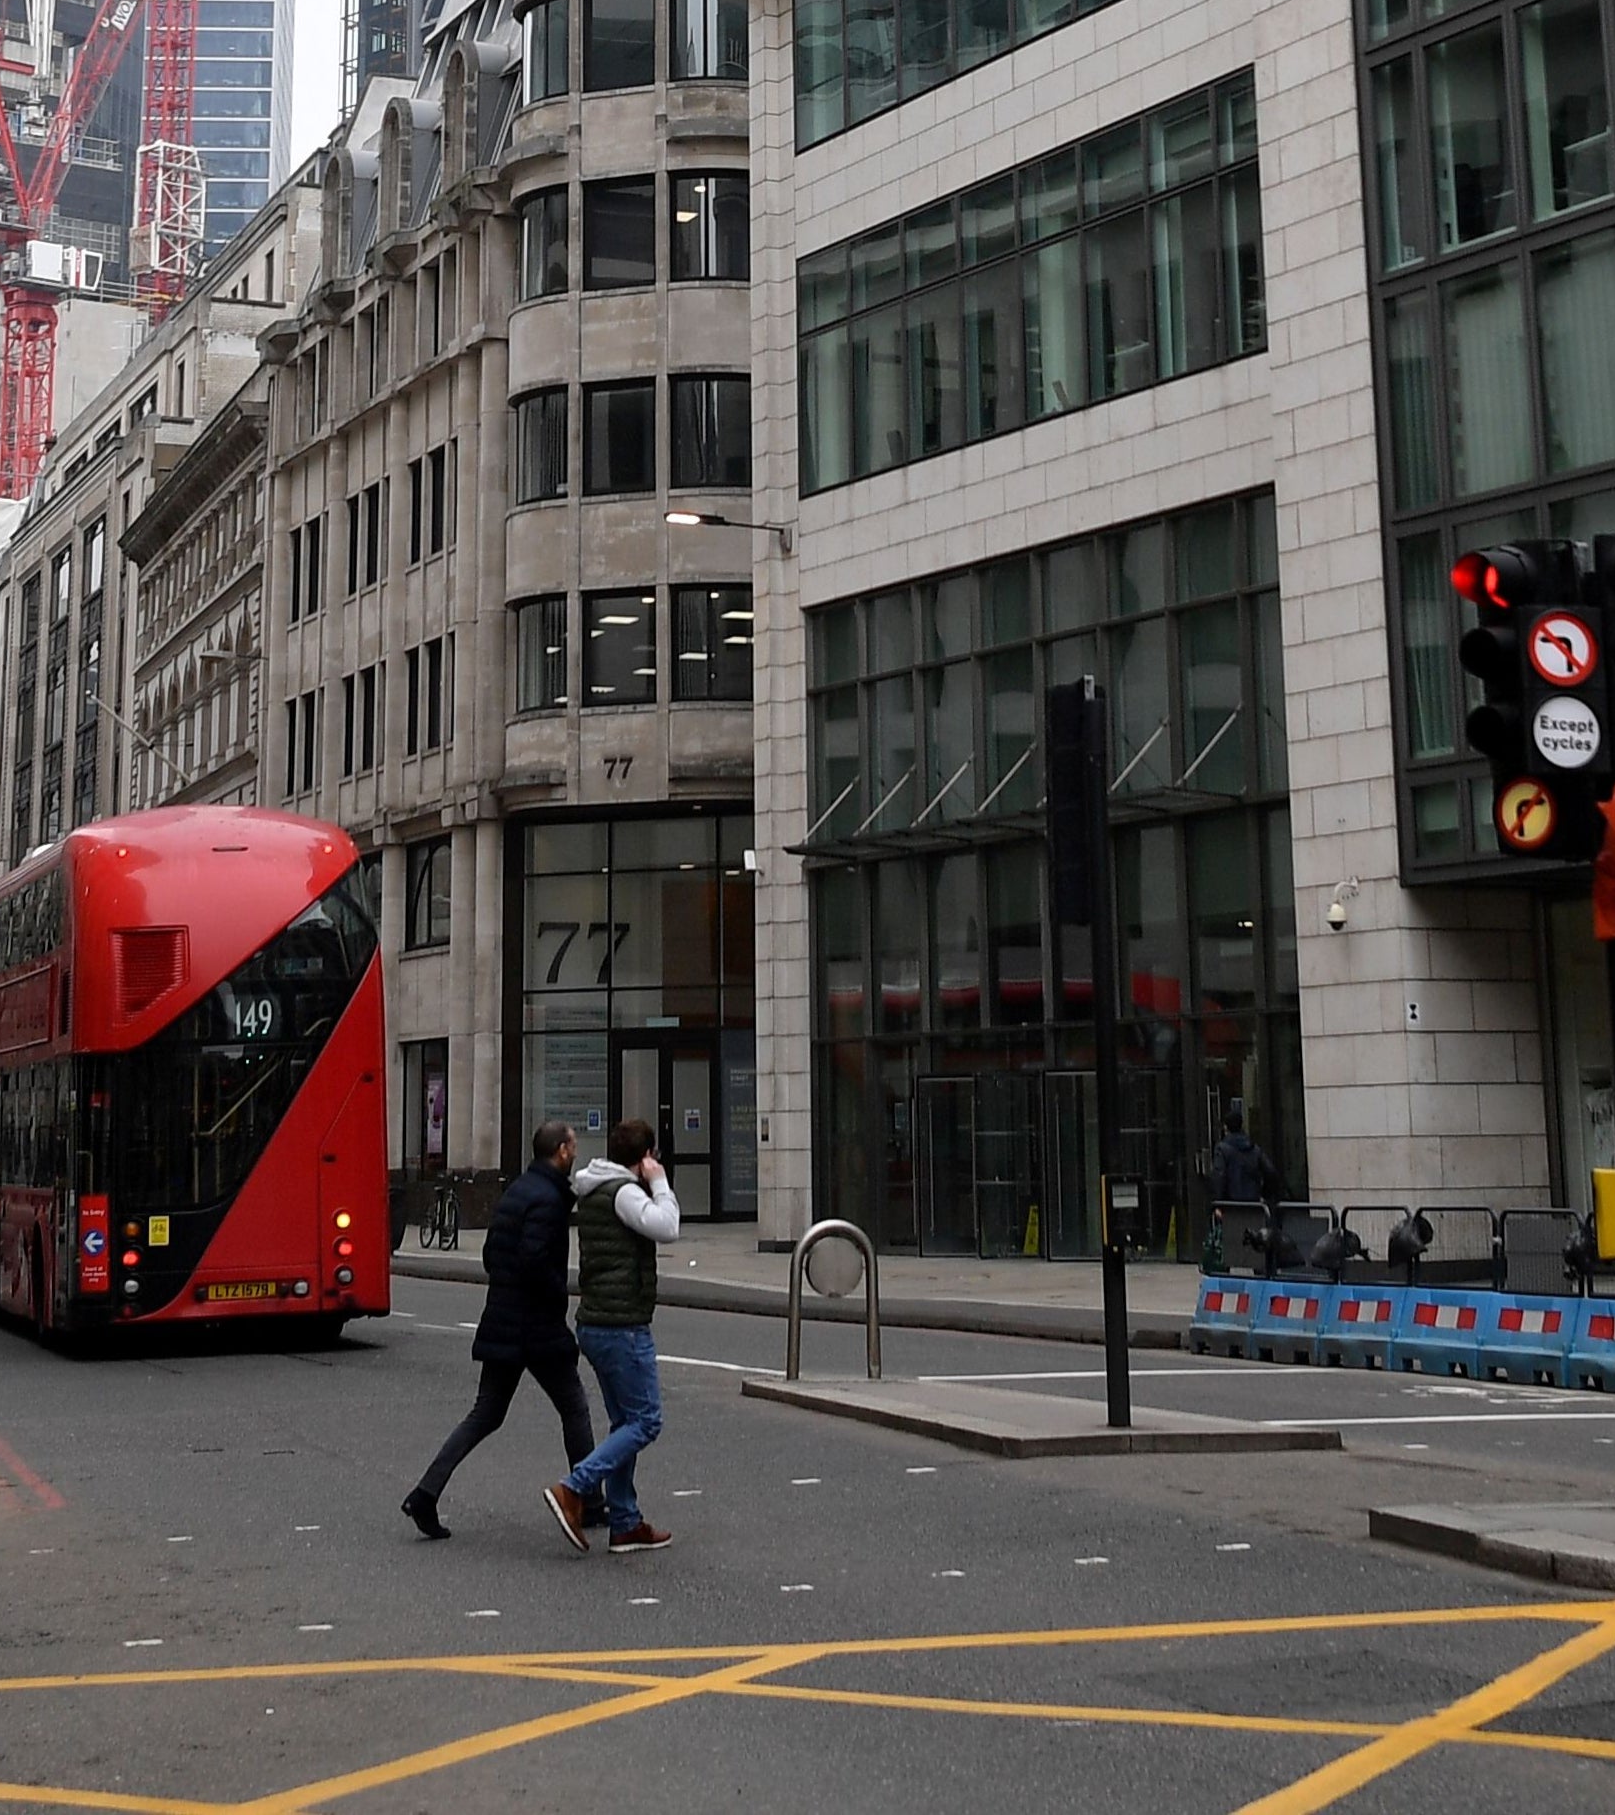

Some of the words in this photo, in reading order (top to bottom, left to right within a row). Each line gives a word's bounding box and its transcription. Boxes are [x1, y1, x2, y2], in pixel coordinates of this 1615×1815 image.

[1540, 715, 1594, 734] Except
[1541, 735, 1592, 752] cycles
[603, 756, 634, 780] 77
[537, 921, 630, 984] 77
[235, 999, 273, 1036] 149
